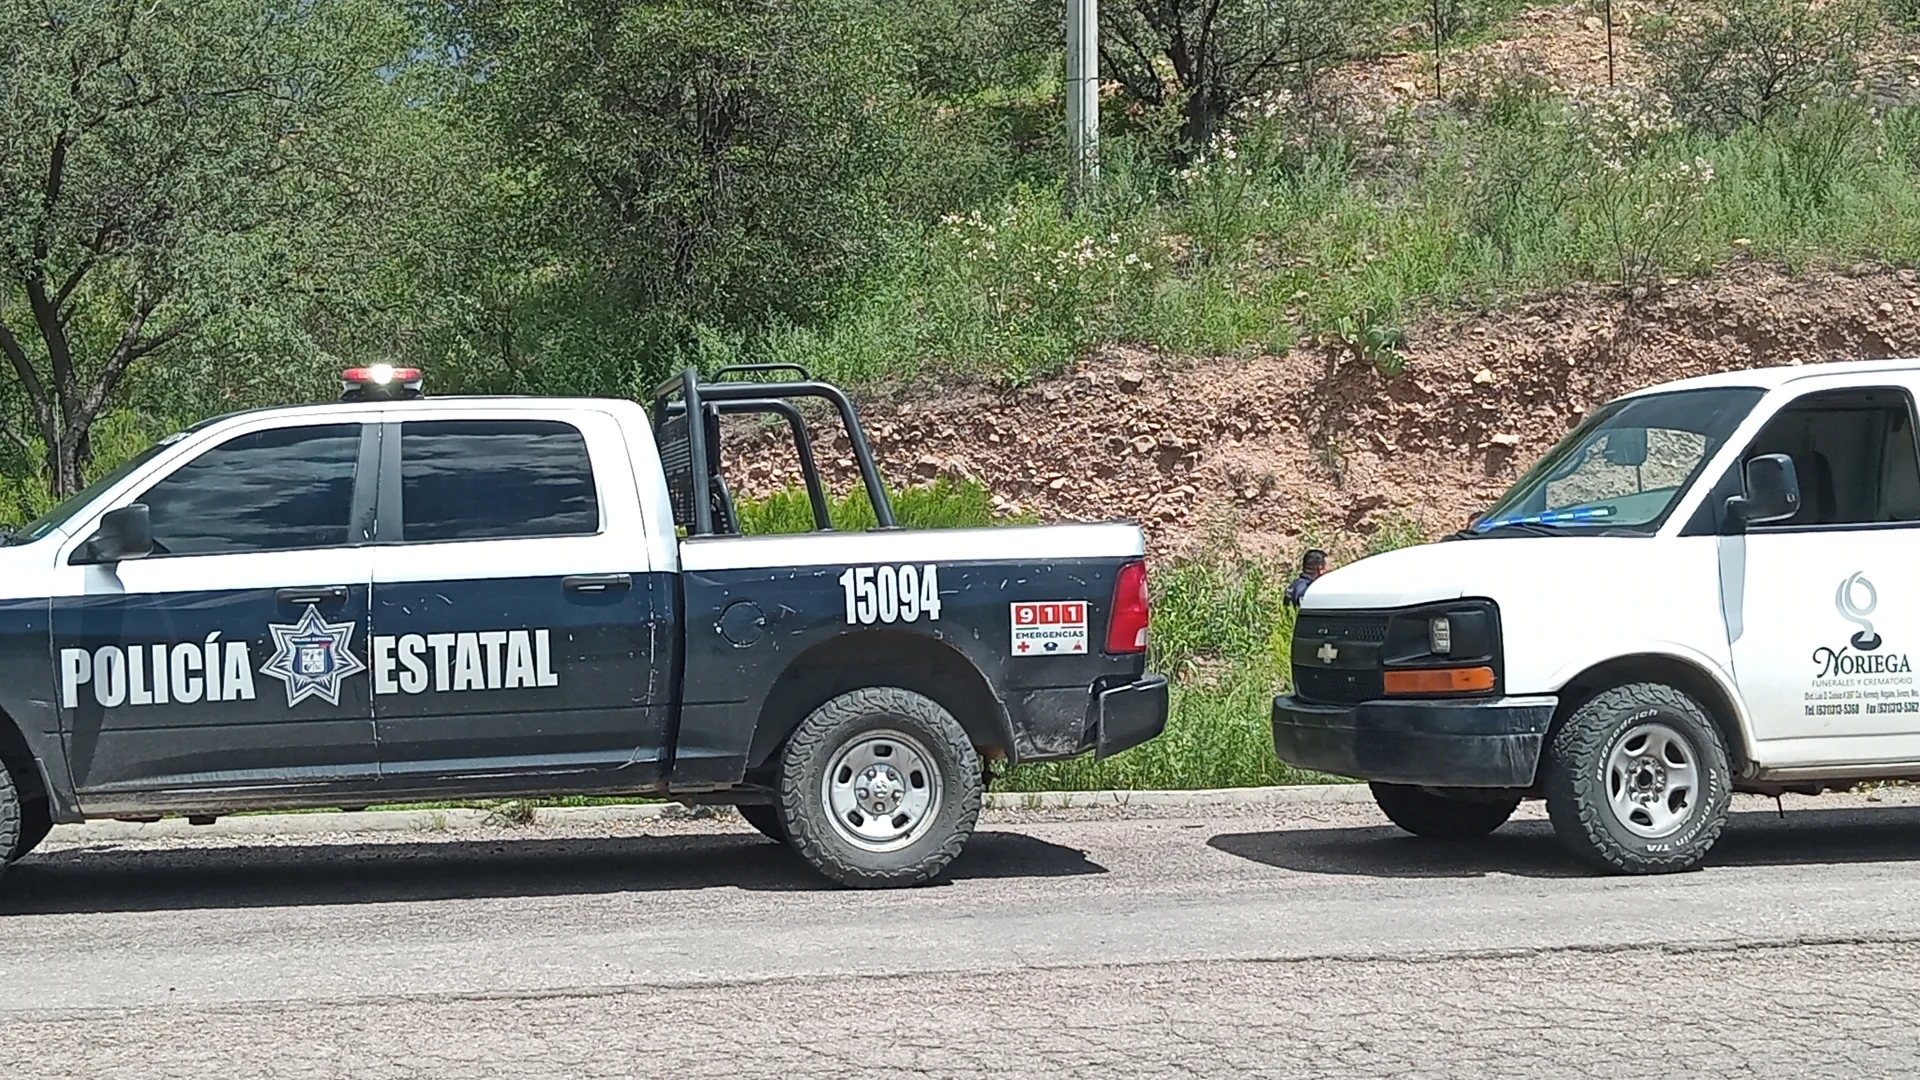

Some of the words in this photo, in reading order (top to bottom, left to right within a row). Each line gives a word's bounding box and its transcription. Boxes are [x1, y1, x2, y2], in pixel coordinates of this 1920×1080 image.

[840, 564, 941, 625] 15094
[1019, 606, 1078, 624] 911
[1015, 630, 1085, 640] EMERGENCIAS
[60, 630, 256, 709] POLICÍA
[374, 629, 559, 695] ESTATAL
[1812, 646, 1912, 679] NORIEGA
[1812, 679, 1855, 688] FUNERALES
[1863, 677, 1913, 687] CREMATORIO
[1646, 843, 1671, 852] T/A
